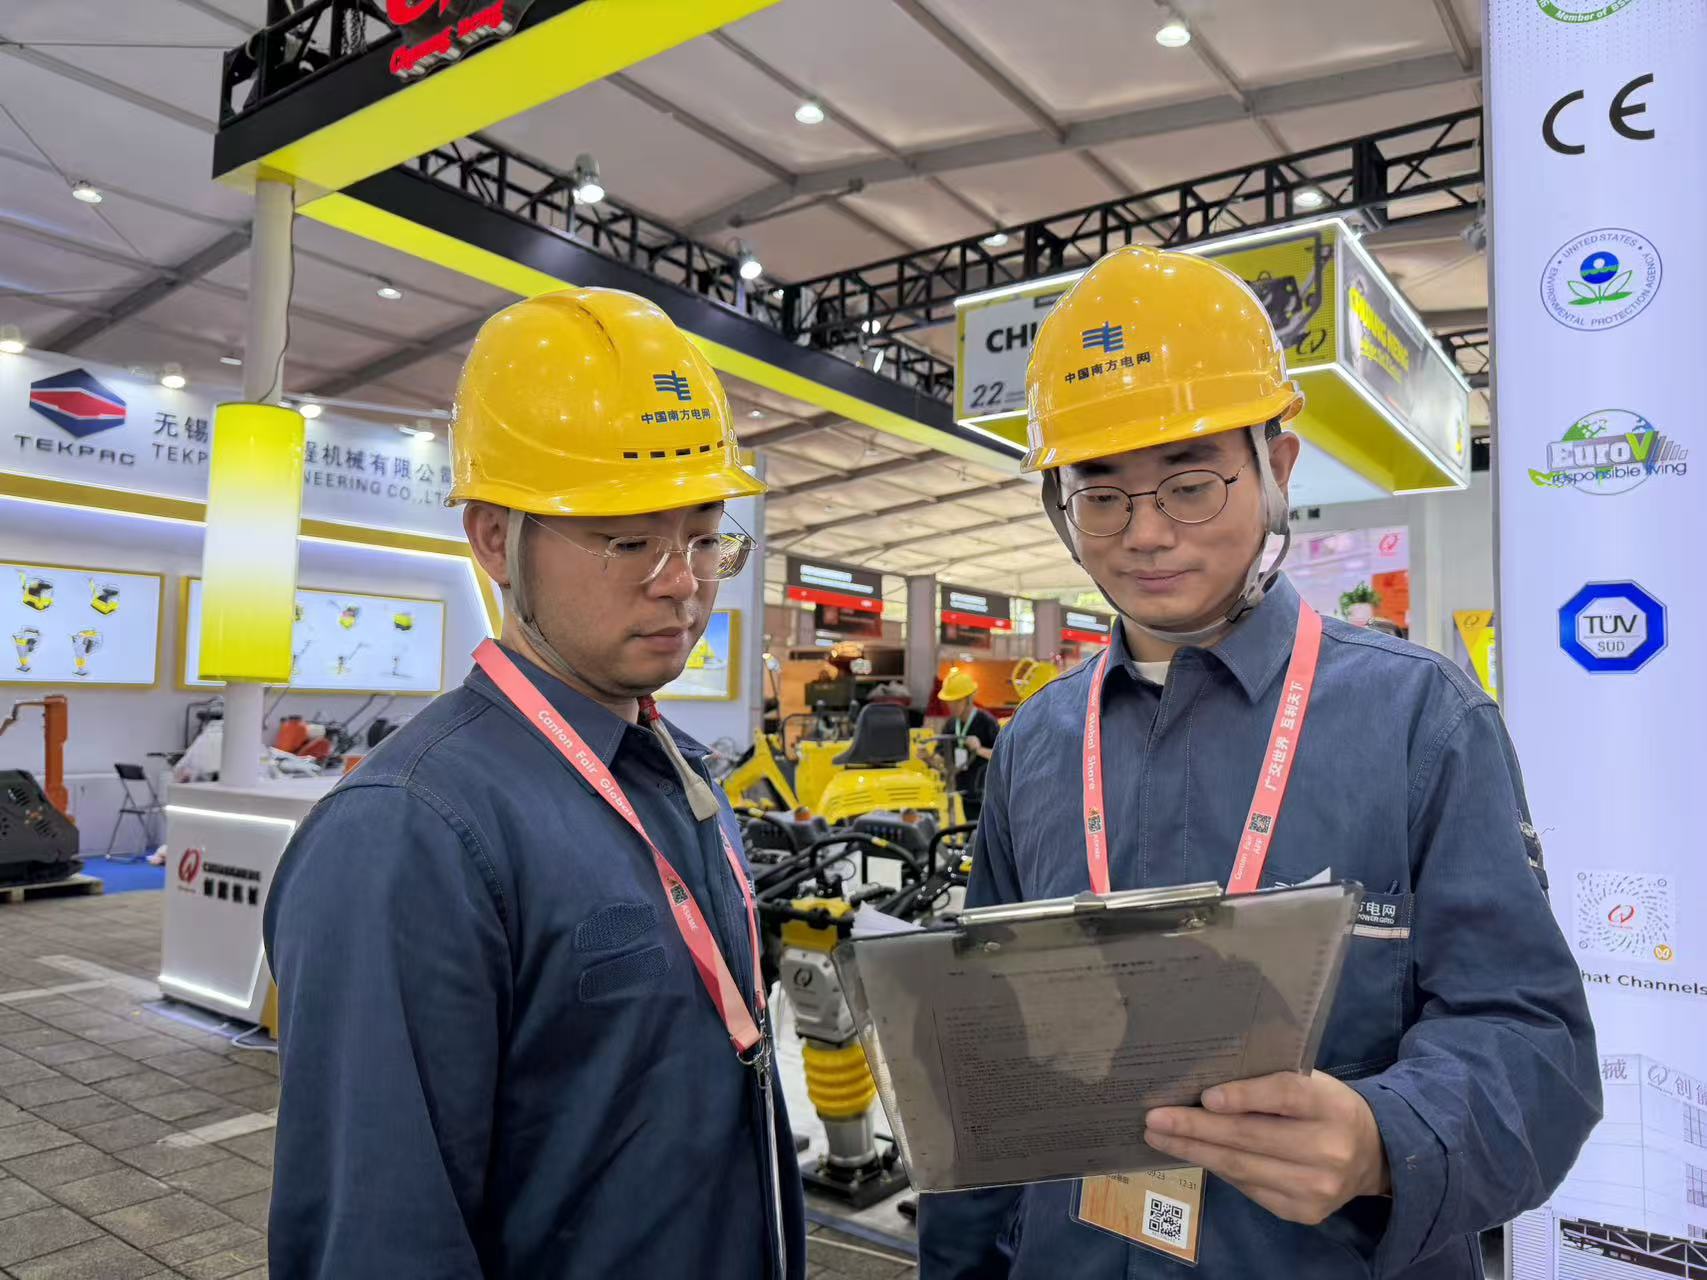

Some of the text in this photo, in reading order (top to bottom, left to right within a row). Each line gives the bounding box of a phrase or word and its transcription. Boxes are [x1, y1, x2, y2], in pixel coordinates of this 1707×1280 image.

[1555, 10, 1594, 21] Member
[1596, 8, 1607, 17] of
[1542, 73, 1655, 155] CE
[1563, 233, 1638, 258] UNITED STATES
[1547, 252, 1656, 327] ENVIRONMENTAL PROTECTION AGENCY
[1064, 351, 1152, 384] 中国南方电网
[971, 382, 1005, 408] 22
[154, 411, 209, 444] 无锡
[641, 407, 711, 424] 中国南方电网
[14, 434, 136, 467] TEKPAC
[151, 443, 209, 466] TEKP
[303, 471, 381, 494] NEERING
[1552, 461, 1687, 485] responsible living
[1583, 614, 1638, 634] TÜV
[1088, 712, 1097, 750] Global
[1264, 681, 1304, 791] 广交世界 互利天下
[538, 710, 634, 817] Canton Fair Global
[1088, 755, 1096, 791] Share
[1581, 970, 1707, 995] hat Channels
[1601, 1058, 1628, 1081] 械
